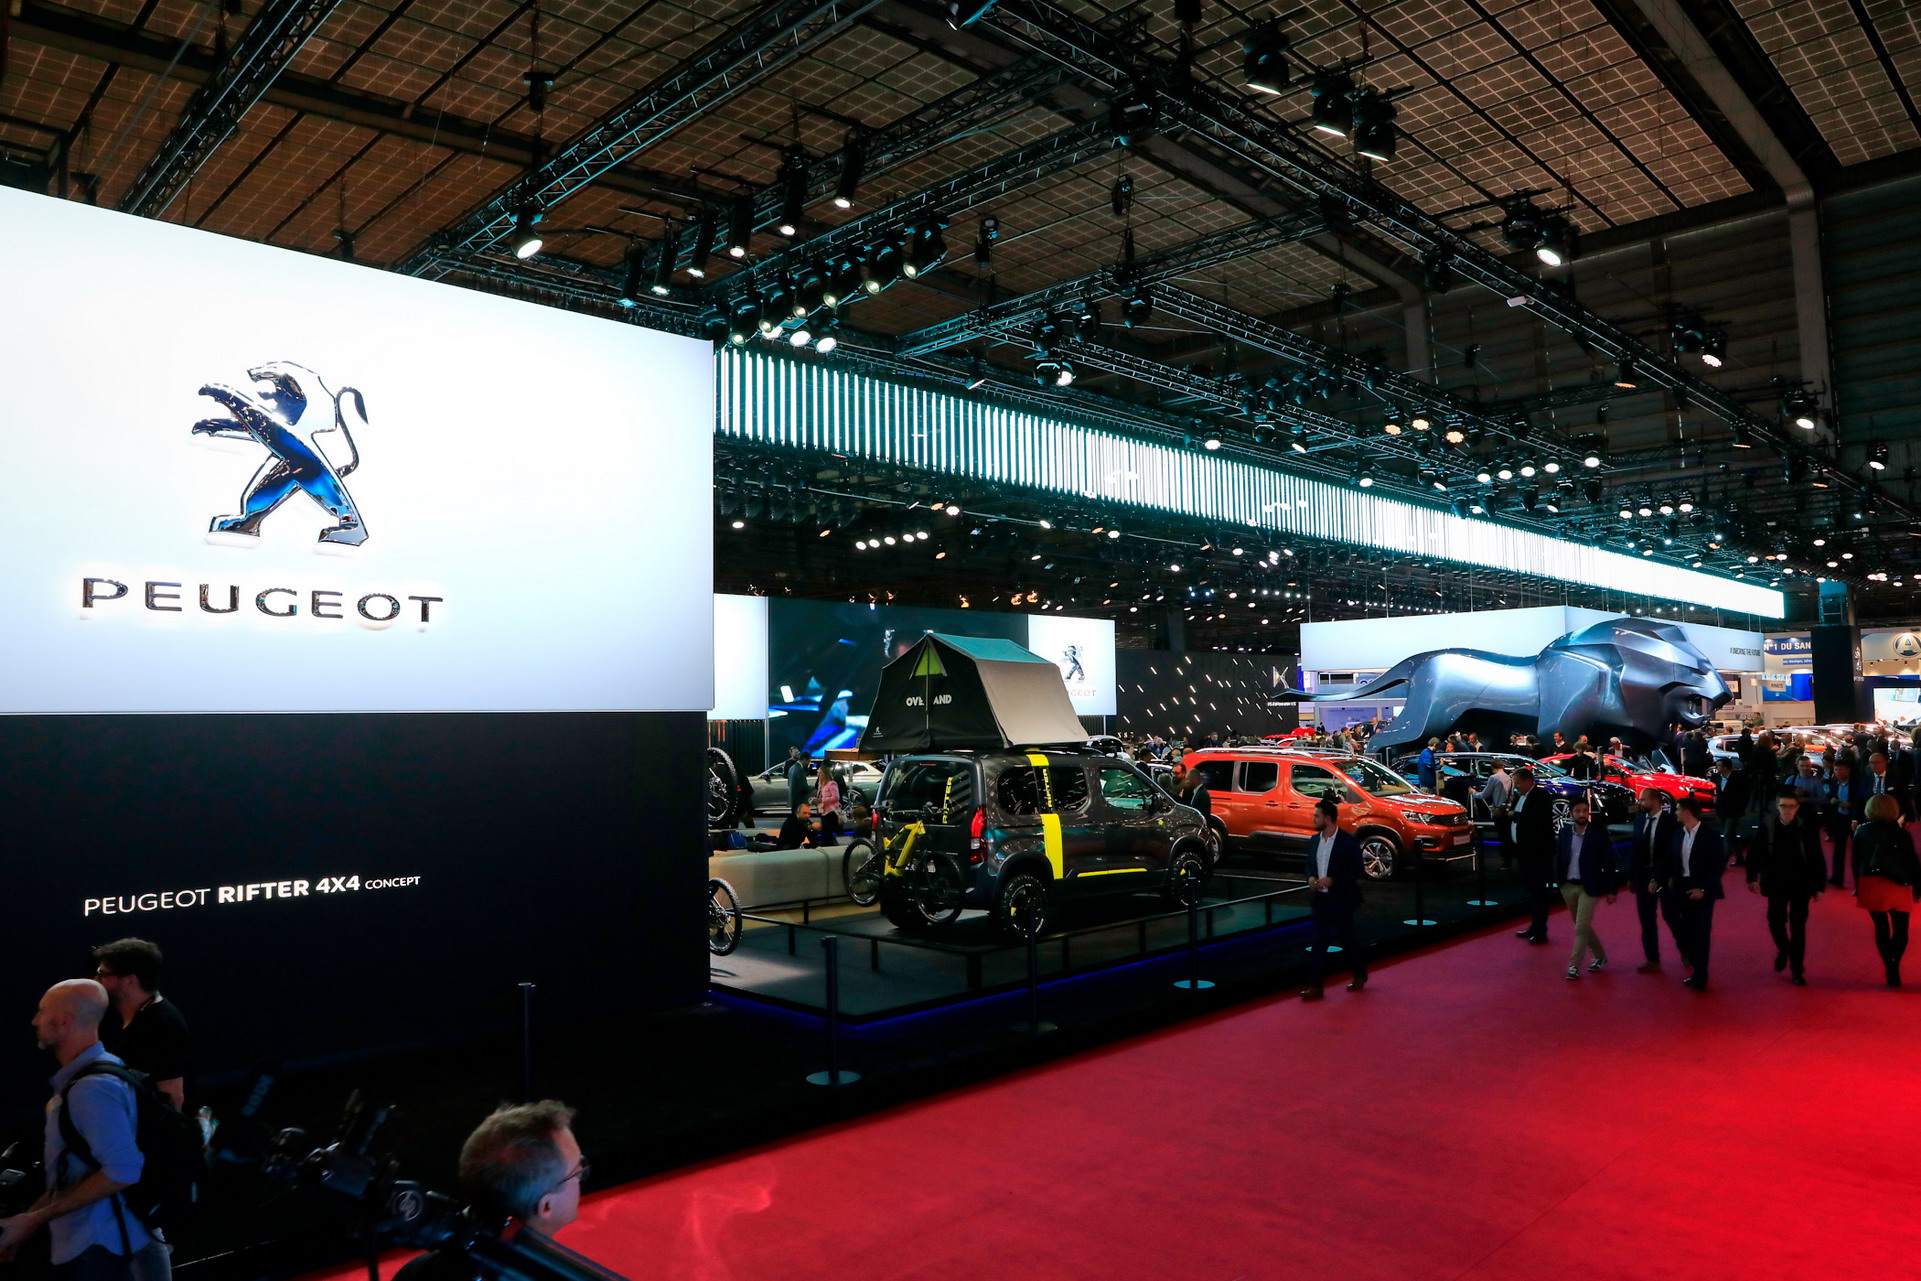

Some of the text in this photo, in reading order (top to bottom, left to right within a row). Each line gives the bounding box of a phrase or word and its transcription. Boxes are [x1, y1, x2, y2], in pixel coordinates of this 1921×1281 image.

[83, 577, 443, 623] PEUGEOT
[84, 875, 421, 916] PEUGEOT RIFTER 4X4 CONCEPT
